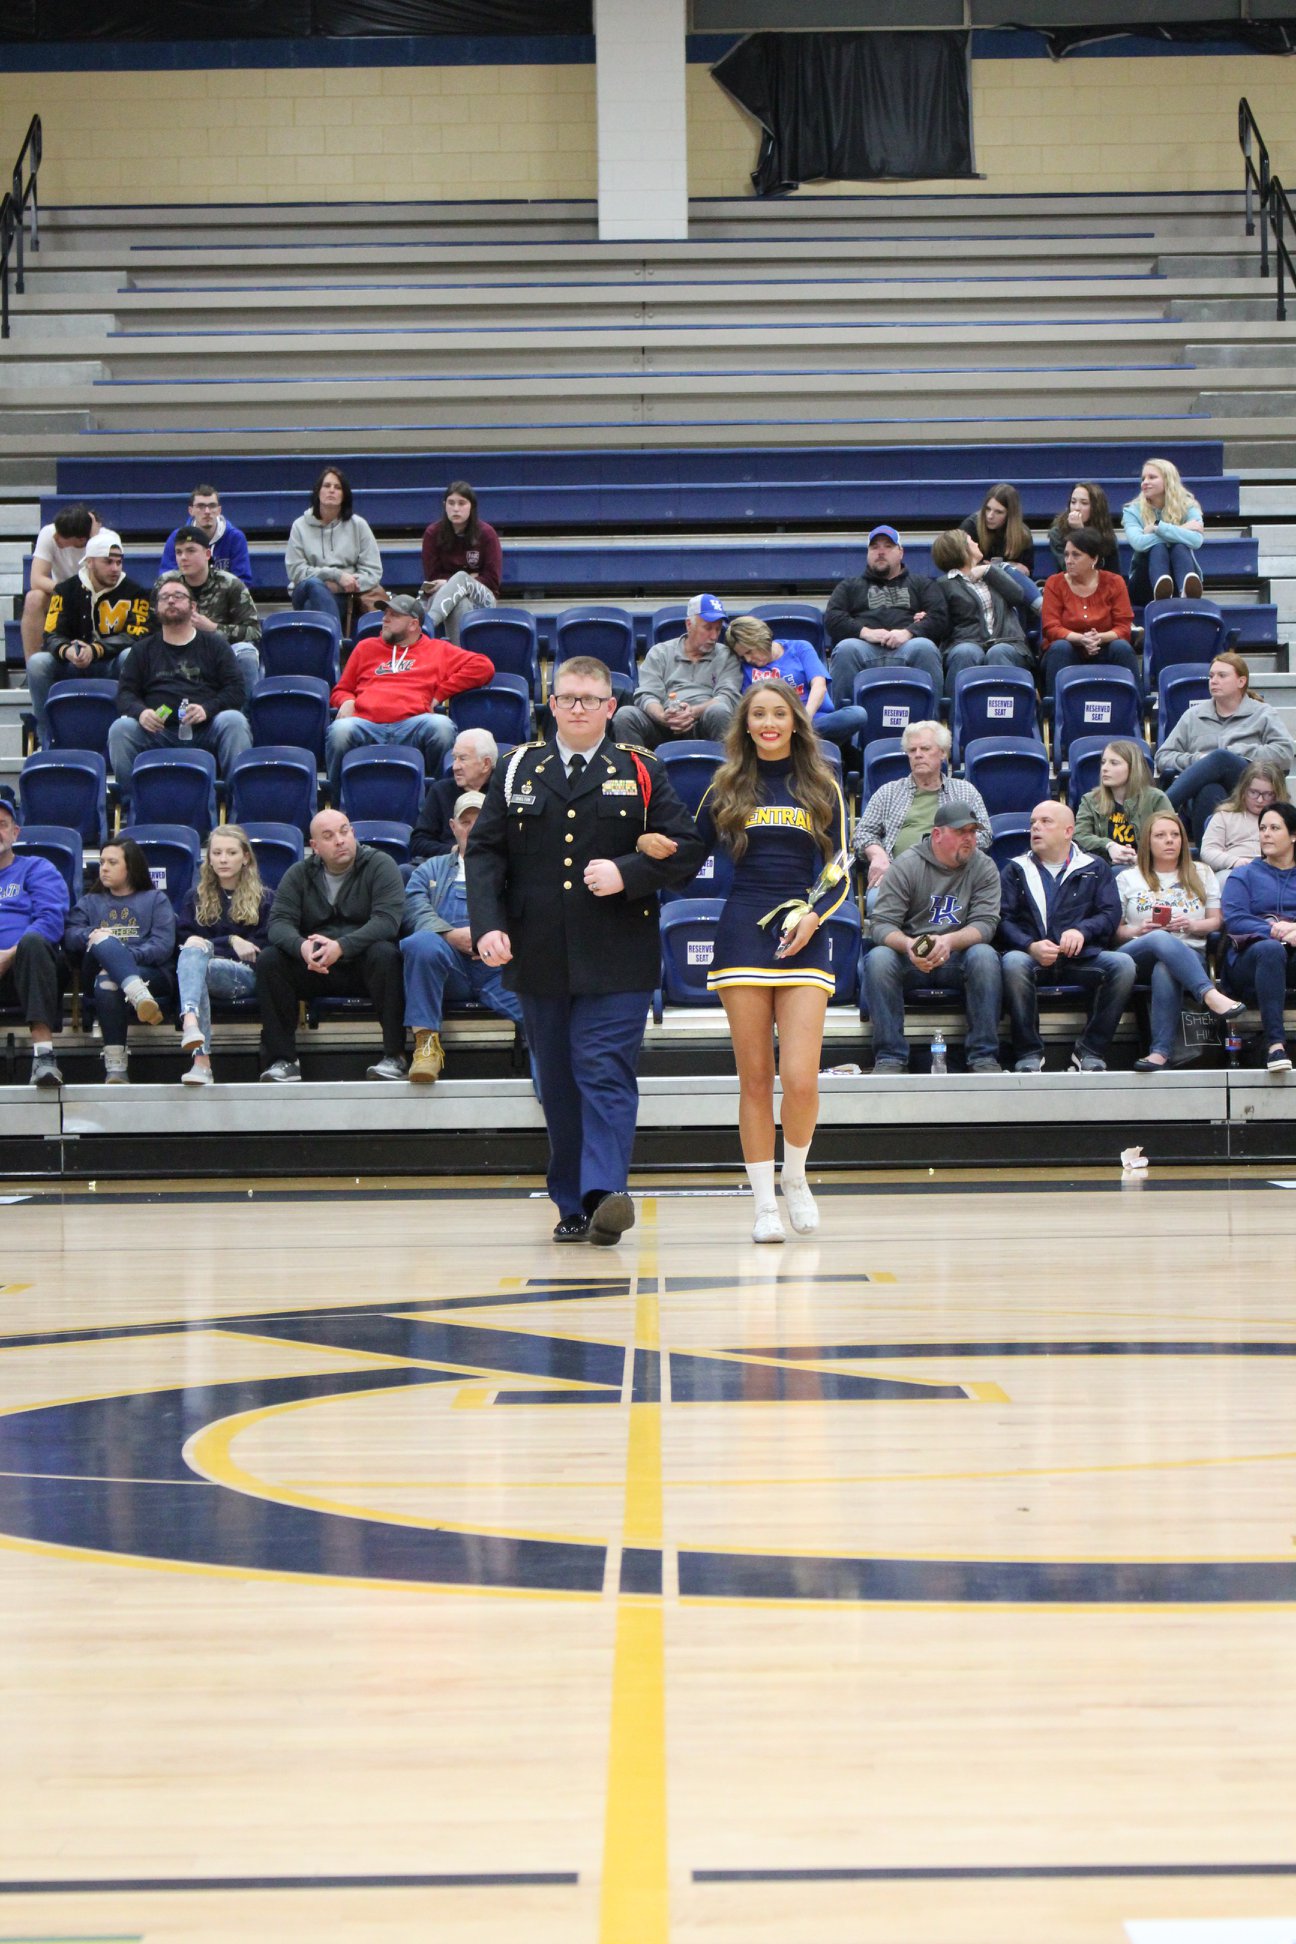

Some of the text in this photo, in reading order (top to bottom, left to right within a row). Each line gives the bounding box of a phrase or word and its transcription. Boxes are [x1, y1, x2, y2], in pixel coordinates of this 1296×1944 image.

[132, 599, 149, 616] 12
[98, 600, 131, 634] M
[988, 699, 1013, 708] RESERVED
[994, 708, 1006, 716] SEAT
[1085, 704, 1111, 713] RESERVED
[884, 709, 909, 718] RESERVED
[1091, 713, 1104, 721] SEAT
[745, 807, 812, 831] ENTRAL
[1113, 824, 1135, 842] KC
[929, 894, 962, 925] UK
[688, 944, 713, 953] RESERVE
[695, 954, 709, 962] SEAT
